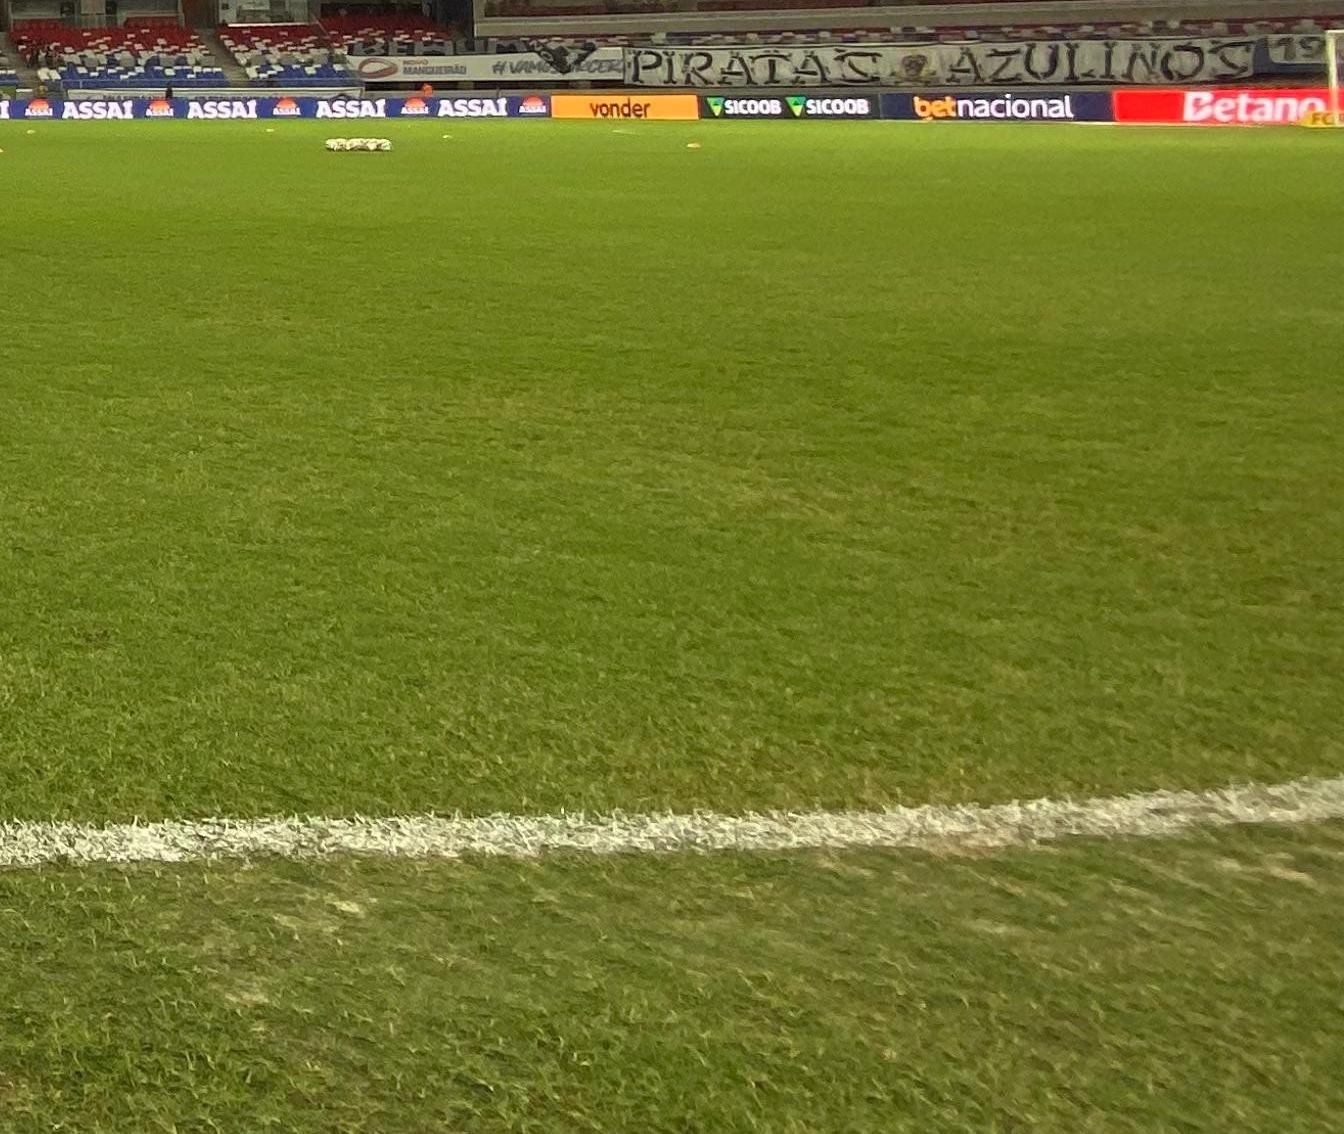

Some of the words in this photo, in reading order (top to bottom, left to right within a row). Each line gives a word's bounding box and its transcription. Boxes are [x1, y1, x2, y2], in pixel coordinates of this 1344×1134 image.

[589, 98, 651, 118] vonder
[724, 99, 781, 115] SICOOB
[806, 98, 869, 115] SICOOB
[914, 93, 1075, 121] betnacional
[1183, 91, 1327, 123] Betano
